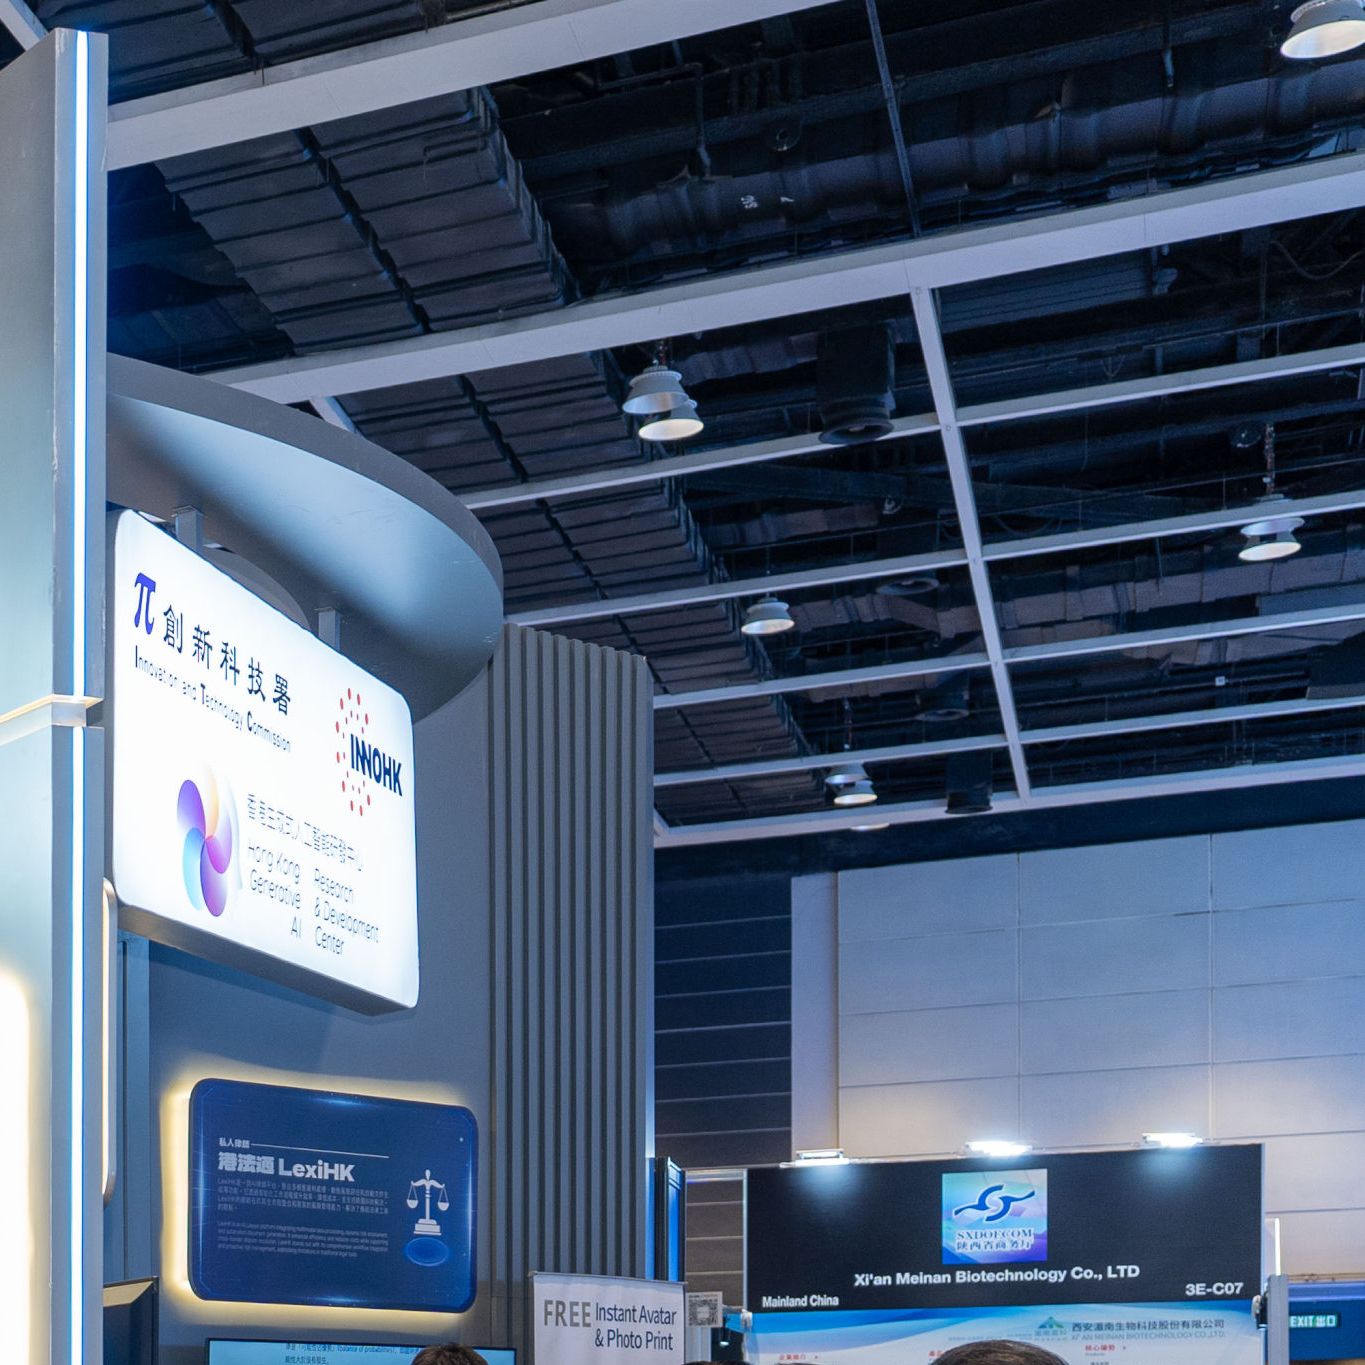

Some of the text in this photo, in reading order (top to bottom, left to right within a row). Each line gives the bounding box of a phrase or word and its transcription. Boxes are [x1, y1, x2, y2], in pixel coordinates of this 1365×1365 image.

[163, 604, 291, 716] 創新科技署
[135, 644, 291, 752] Innovation and Technology Commission
[350, 733, 403, 797] INNOHK
[248, 838, 300, 885] Hong Kong
[249, 868, 301, 910] Generative
[314, 867, 354, 904] Research
[290, 915, 302, 939] AI
[314, 896, 379, 943] & Development
[315, 925, 345, 955] Center
[218, 1152, 355, 1182] 港法通 LexiHK
[854, 1264, 1141, 1288] Xi'an Meinan Biotechnology Co., LTD
[1185, 1282, 1244, 1297] 3E-C07
[543, 1299, 677, 1328] FREE Instant Avatar
[762, 1294, 839, 1308] Mainland China
[1290, 1315, 1337, 1328] EXIT 出口
[595, 1328, 674, 1351] & Photo Print
